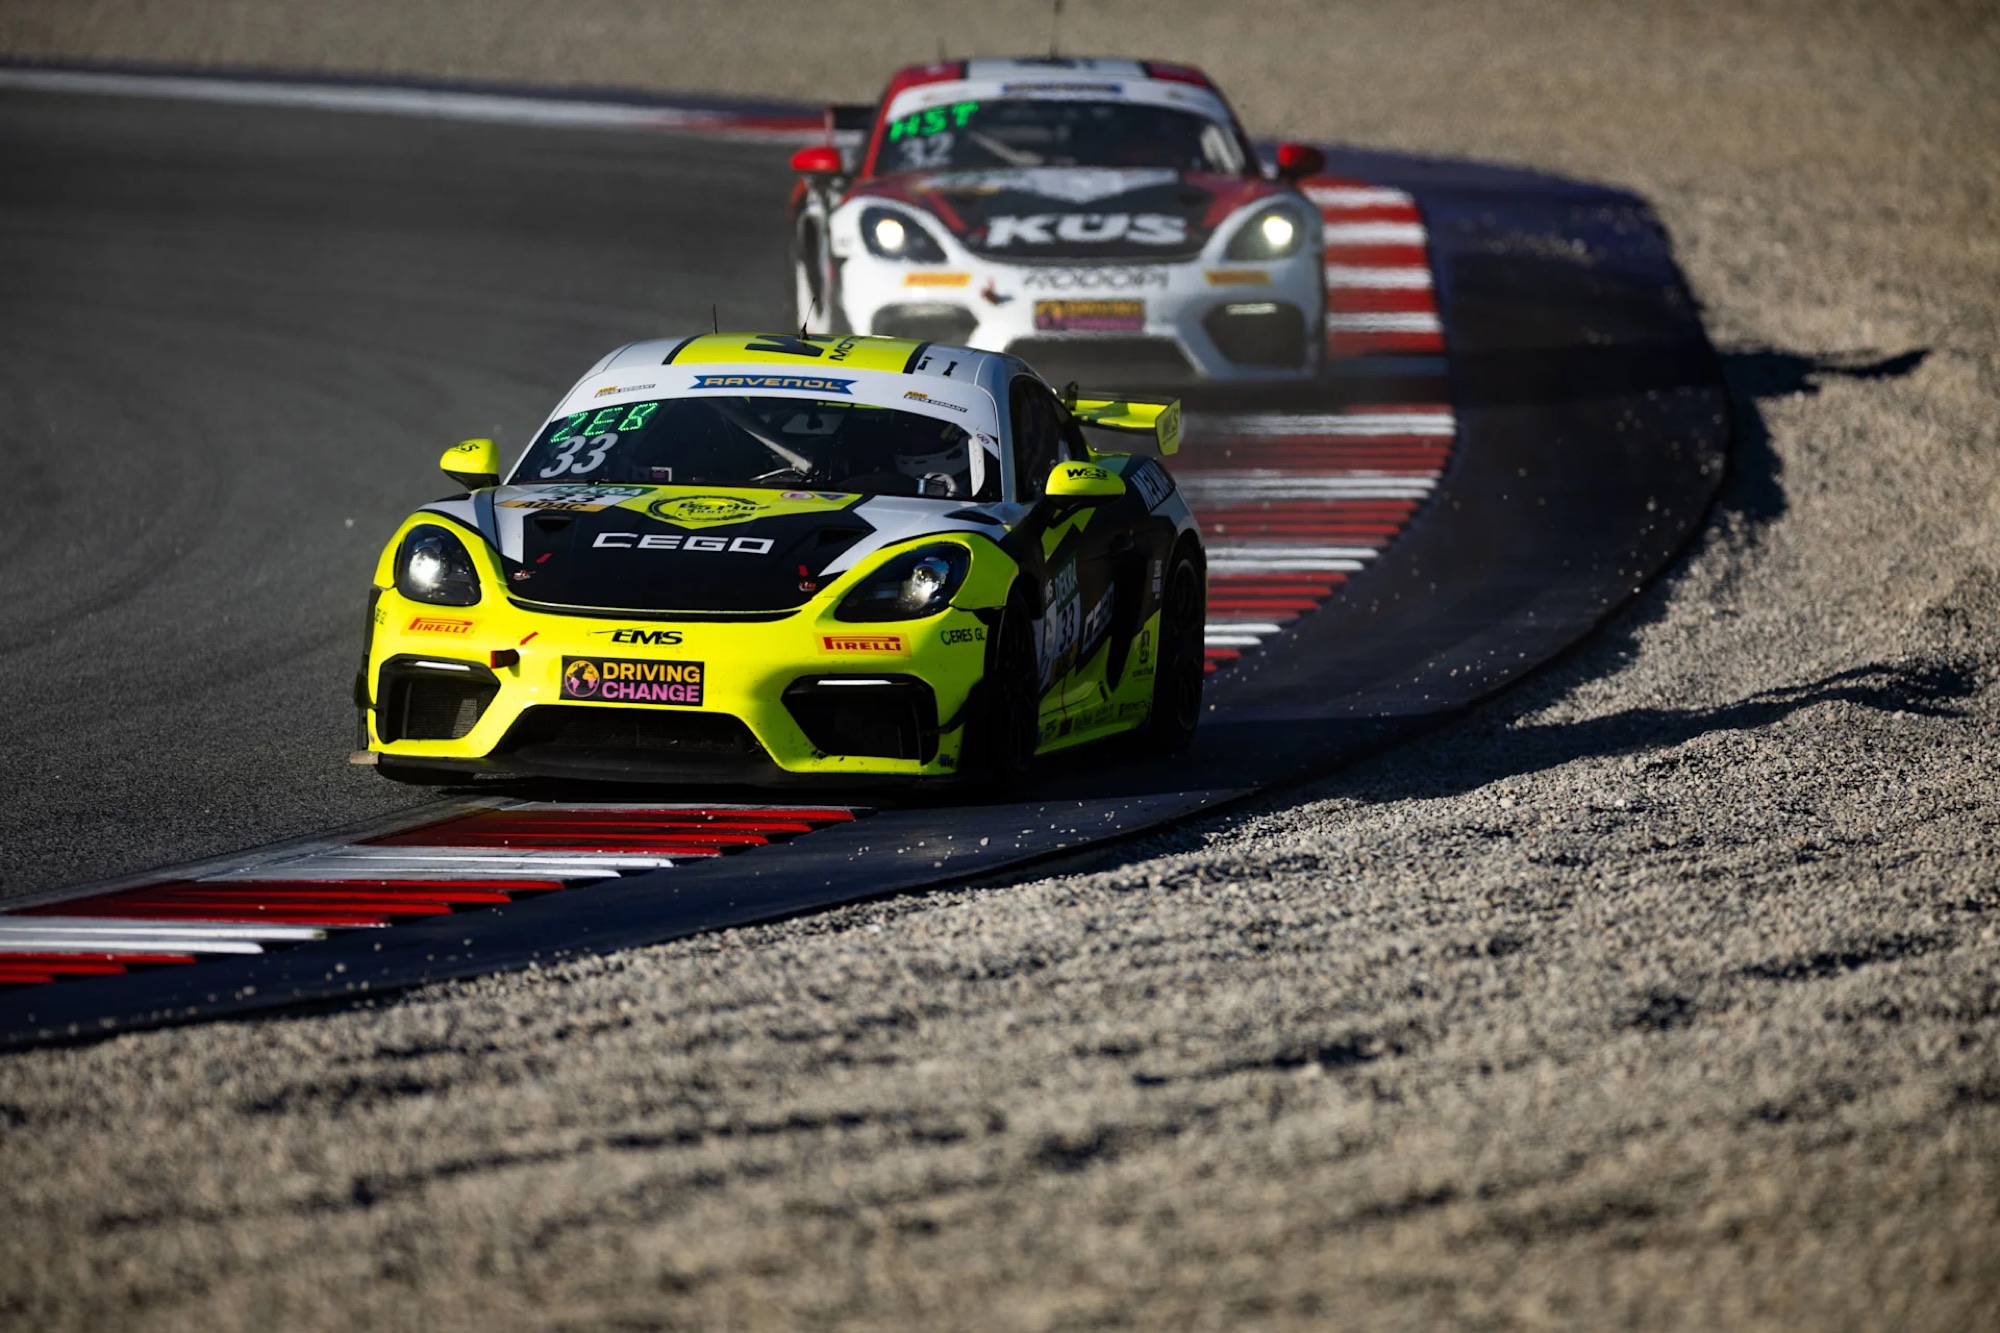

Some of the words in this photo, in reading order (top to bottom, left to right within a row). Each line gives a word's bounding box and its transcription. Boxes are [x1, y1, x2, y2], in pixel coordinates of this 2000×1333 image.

[889, 101, 979, 142] HST
[704, 378, 842, 390] RAVENOL
[540, 433, 618, 478] 33
[592, 533, 775, 554] CEGO
[408, 617, 473, 633] PIRELLI
[1058, 602, 1075, 653] 33
[612, 629, 683, 645] EMS
[823, 636, 902, 651] PIRELLI
[940, 628, 973, 646] CERES
[602, 662, 701, 682] DRIVING
[601, 681, 700, 702] CHANGE
